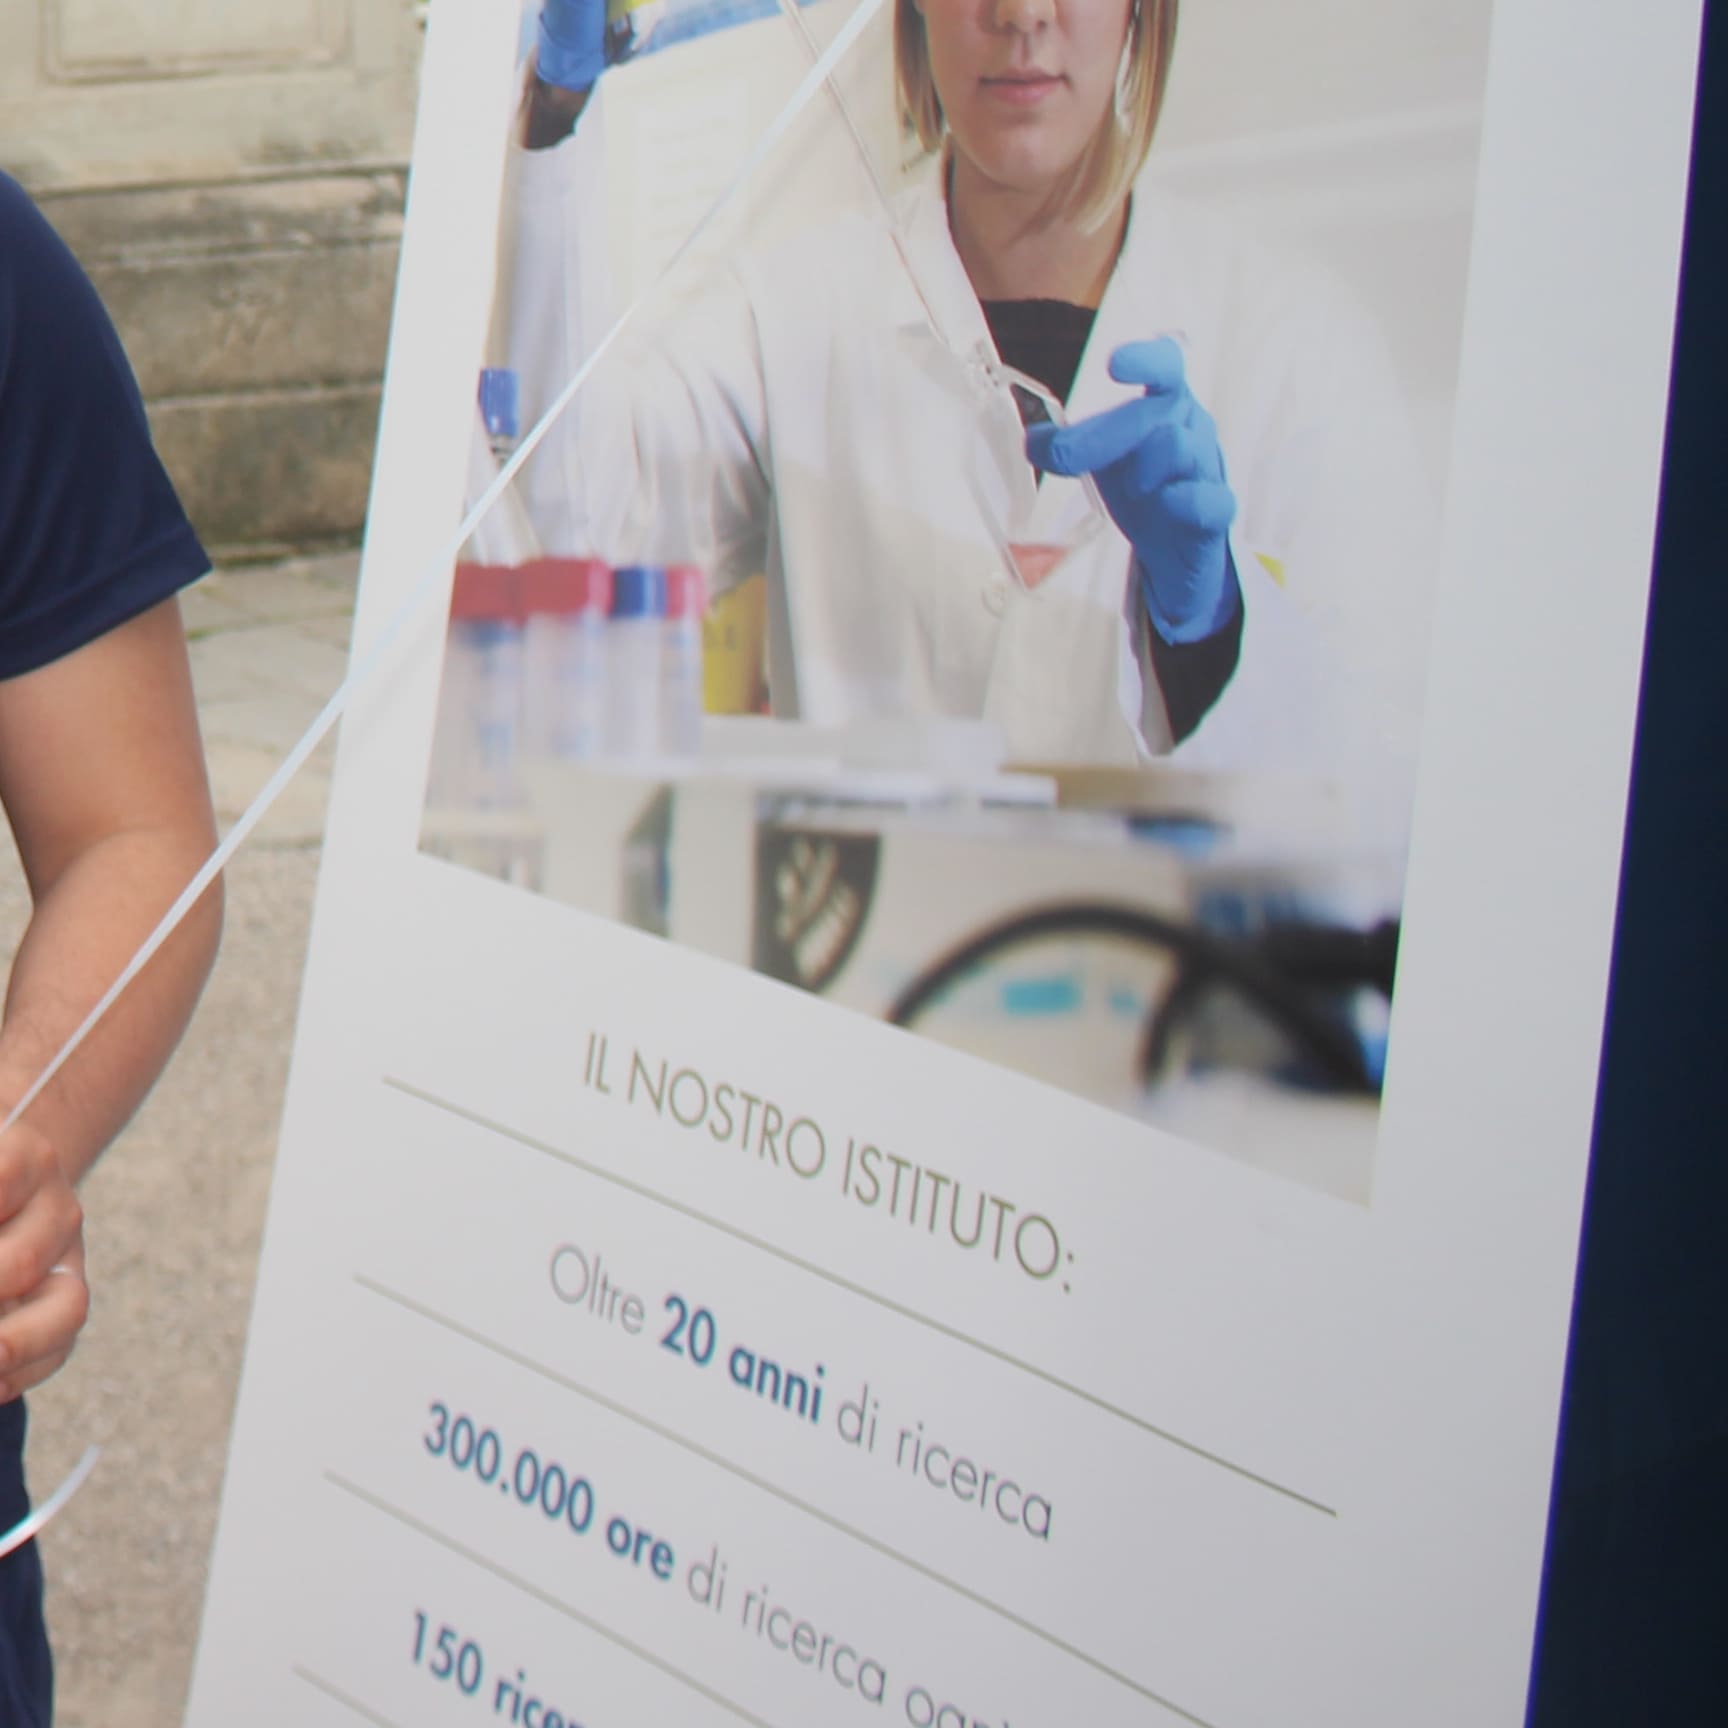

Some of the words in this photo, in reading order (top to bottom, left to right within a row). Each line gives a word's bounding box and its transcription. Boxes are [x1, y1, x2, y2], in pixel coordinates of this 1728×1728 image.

[584, 1032, 611, 1094] IL
[628, 1049, 826, 1179] NOSTRO
[843, 1138, 1075, 1294] ISTITUTO:
[549, 1243, 645, 1335] Oltre
[660, 1293, 718, 1367] 20
[728, 1345, 826, 1425] anni
[837, 1384, 880, 1453] di
[895, 1422, 1053, 1541] ricerca
[414, 1608, 484, 1696] 150
[422, 1401, 596, 1535] 300.000
[606, 1513, 674, 1581] ore
[687, 1546, 727, 1613] di
[742, 1585, 888, 1706] ricerca
